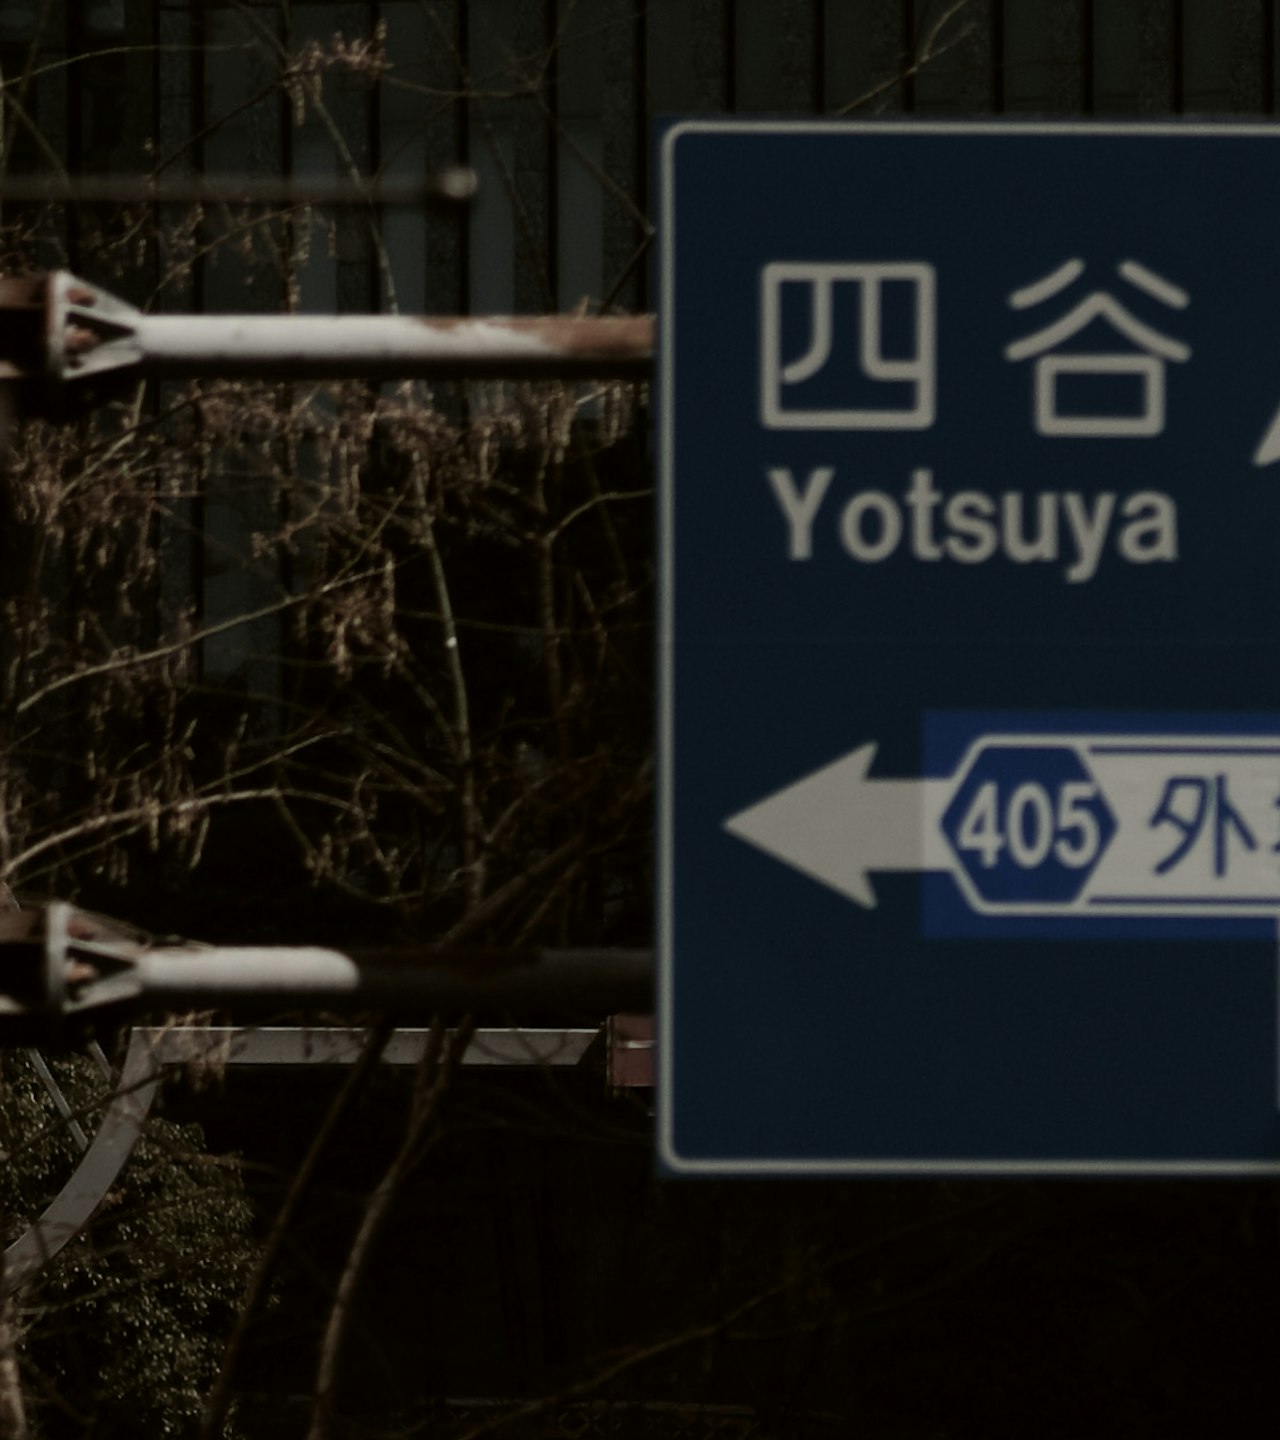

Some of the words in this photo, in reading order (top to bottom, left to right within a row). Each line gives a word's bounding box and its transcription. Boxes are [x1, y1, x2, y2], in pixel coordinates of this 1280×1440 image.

[758, 257, 1193, 438] 四谷
[766, 466, 1179, 583] Yotsuya
[956, 782, 1103, 869] 405
